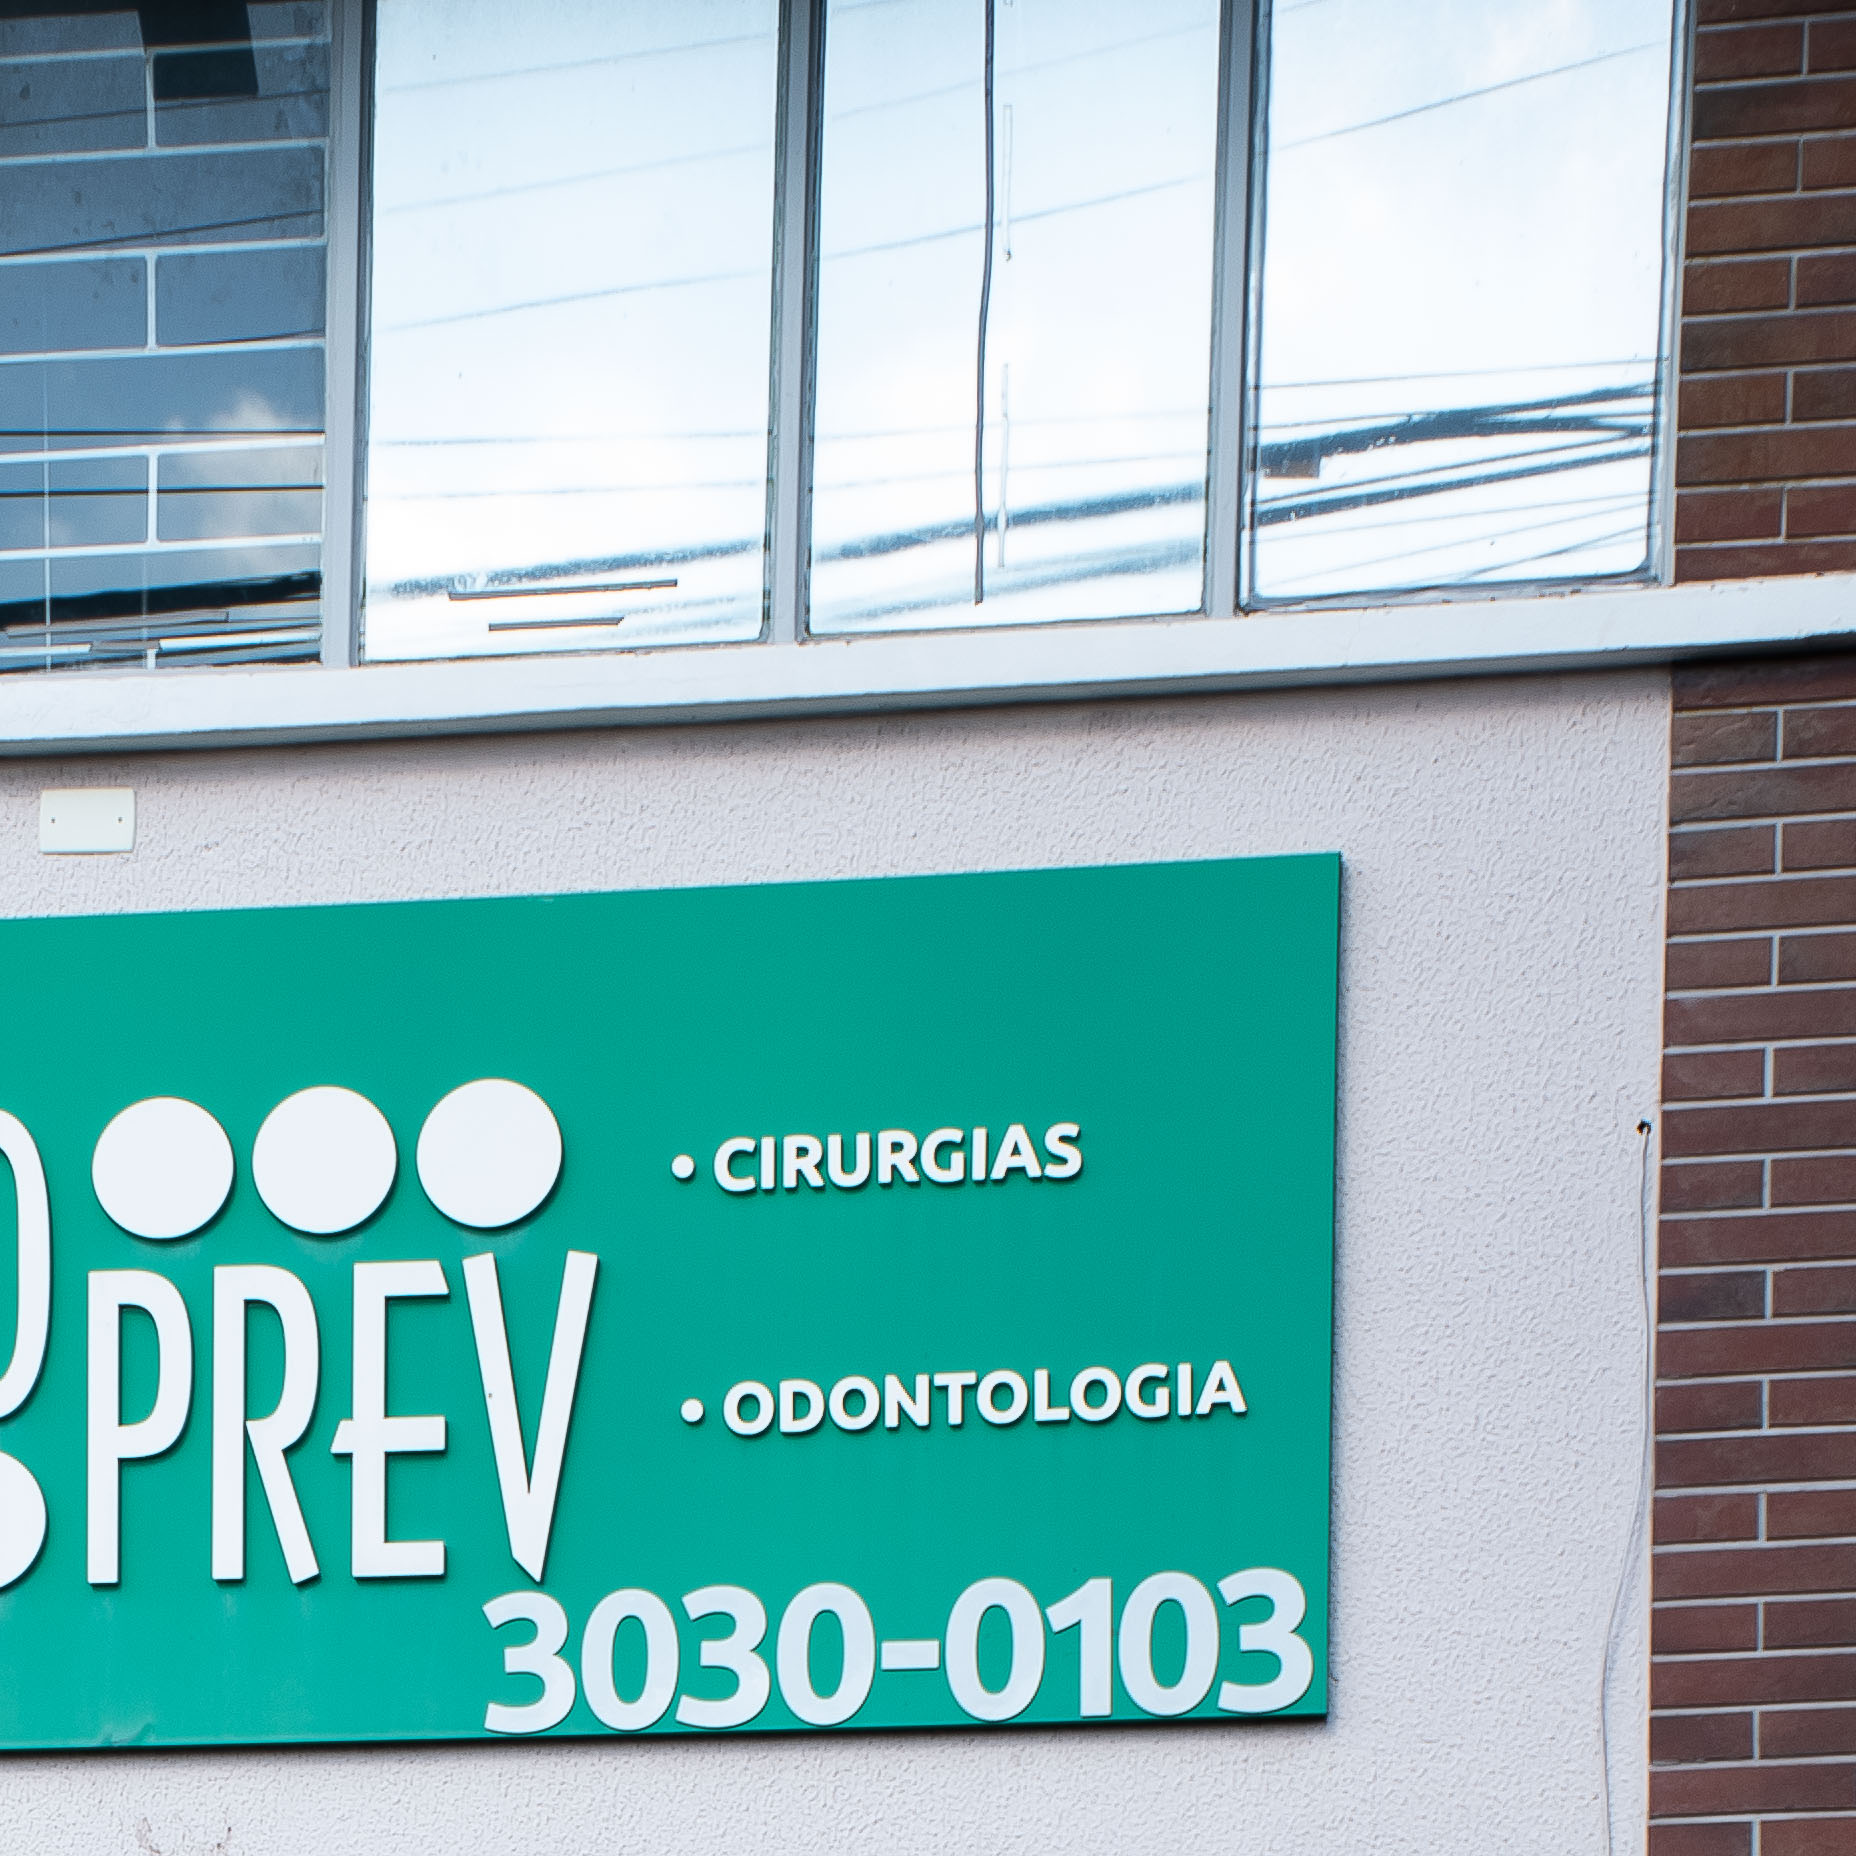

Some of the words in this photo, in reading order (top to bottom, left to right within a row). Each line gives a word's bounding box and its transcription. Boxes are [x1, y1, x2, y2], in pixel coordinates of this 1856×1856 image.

[713, 1122, 1084, 1194] CIRURGIAS
[87, 1250, 598, 1585] PREV
[722, 1360, 1248, 1438] ODONTOLOGIA
[481, 1568, 1315, 1735] 3030-0103
